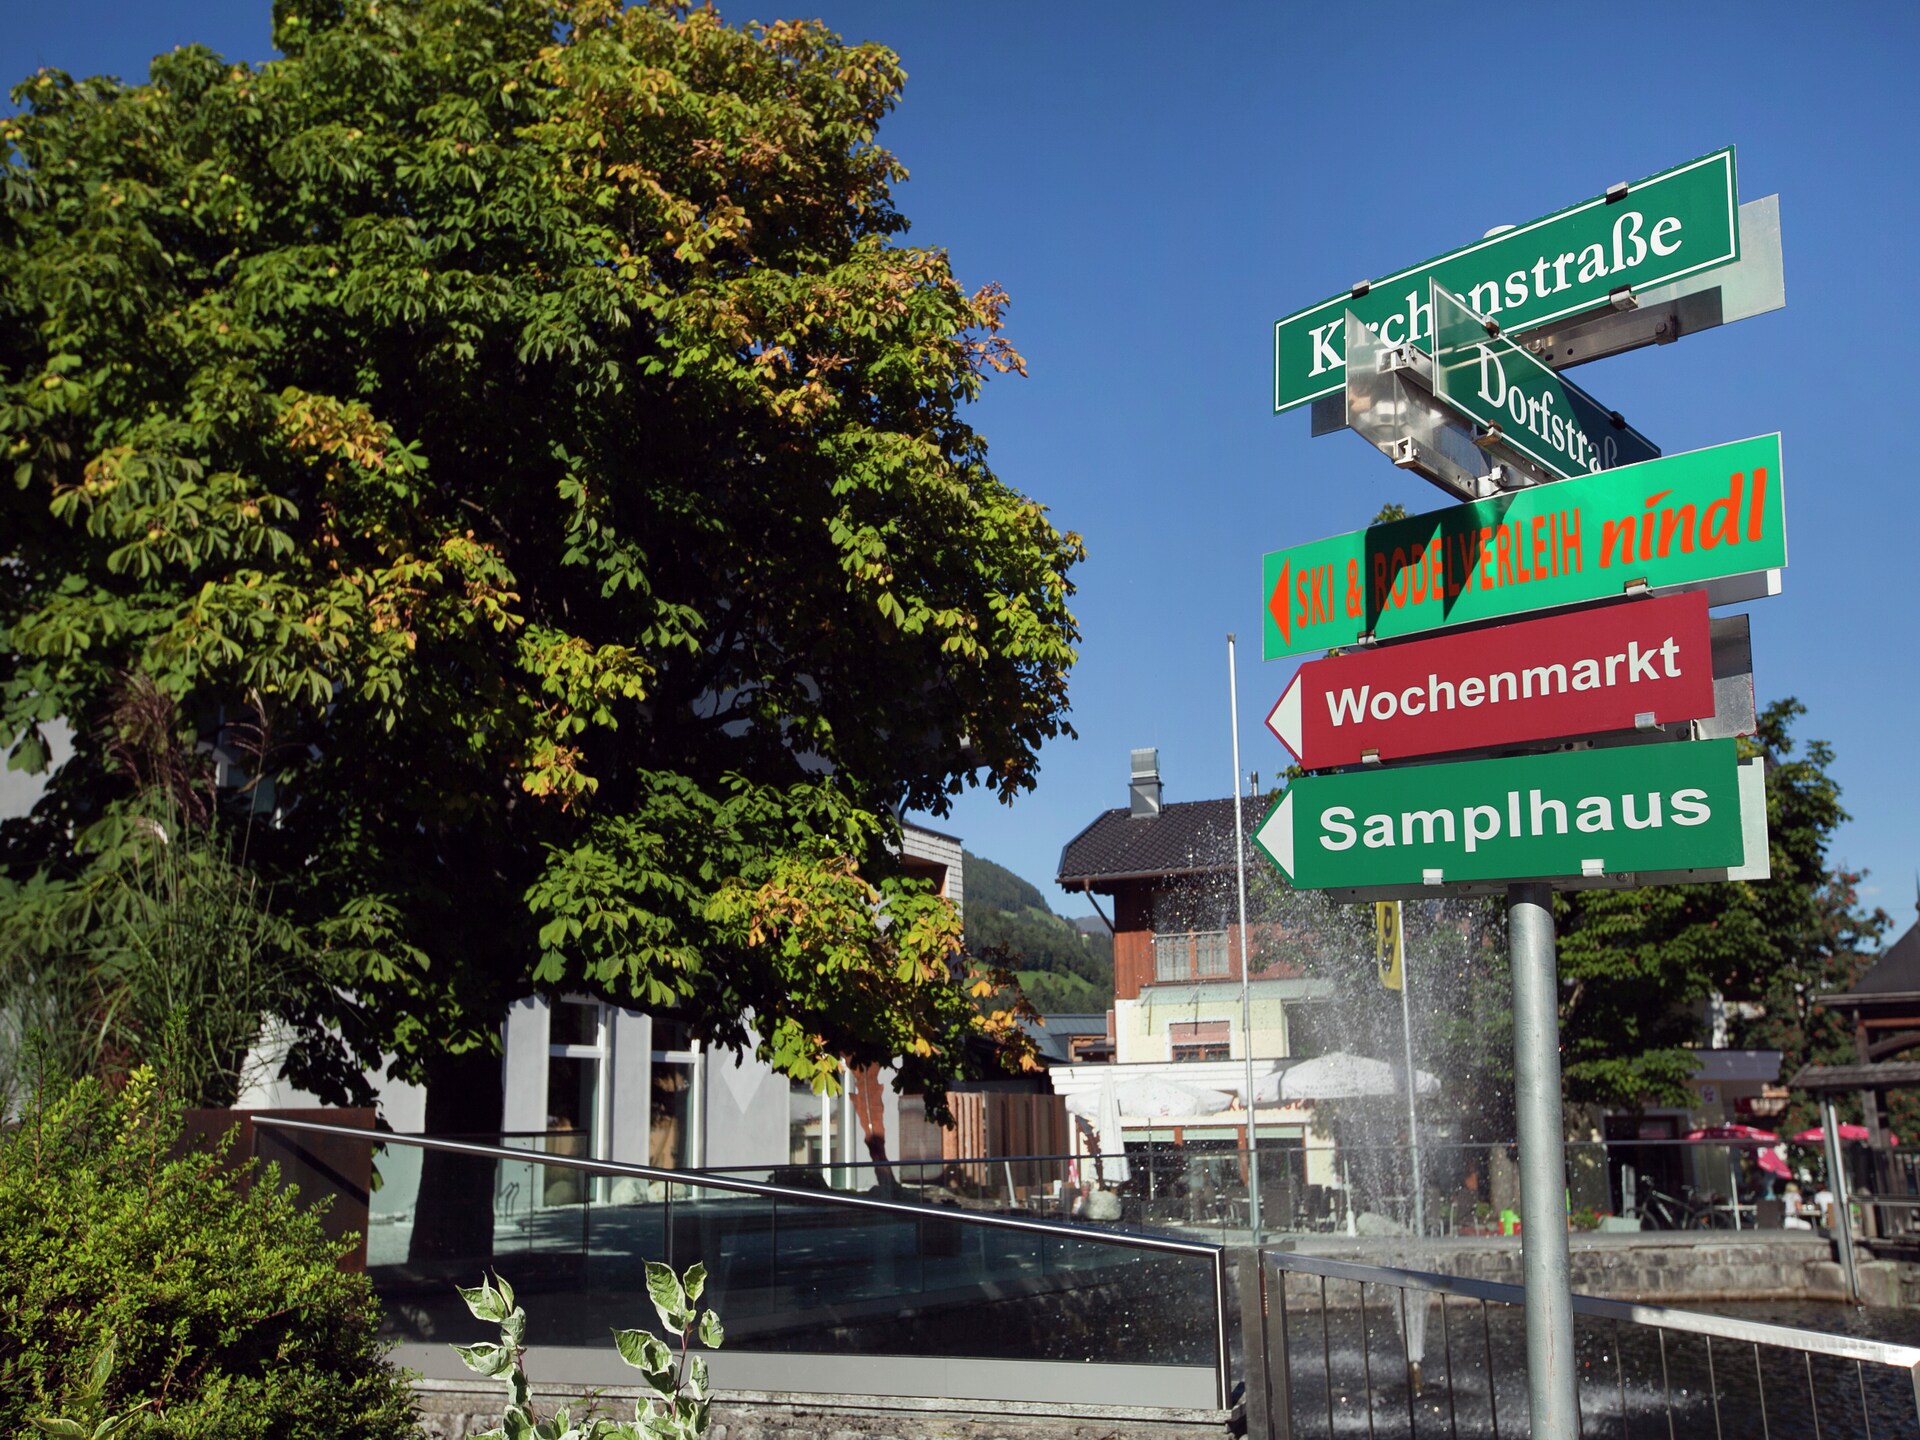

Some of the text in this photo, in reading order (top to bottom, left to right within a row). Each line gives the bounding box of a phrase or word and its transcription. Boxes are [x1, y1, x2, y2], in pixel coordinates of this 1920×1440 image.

[1308, 211, 1683, 378] Kchnstraße
[1478, 342, 1618, 474] Dorfstraß
[1296, 563, 1334, 629] SKI
[1345, 557, 1363, 619] &
[1374, 508, 1583, 612] RODELVERLEIH
[1325, 636, 1682, 726] Wochenmarkt
[1319, 787, 1712, 853] Samplhaus
